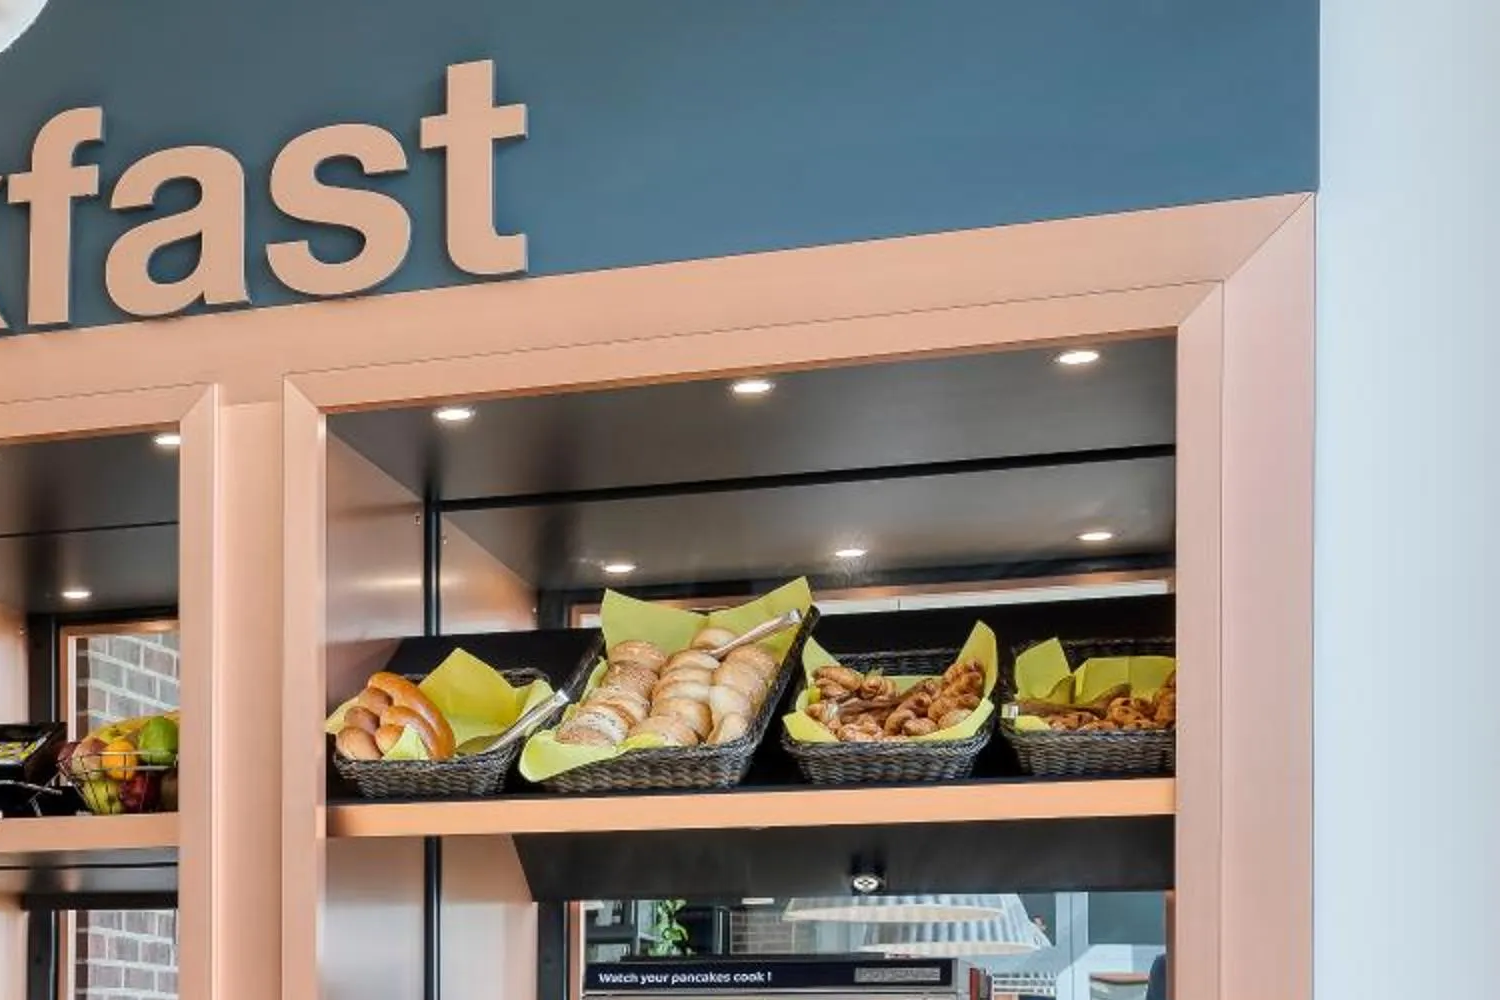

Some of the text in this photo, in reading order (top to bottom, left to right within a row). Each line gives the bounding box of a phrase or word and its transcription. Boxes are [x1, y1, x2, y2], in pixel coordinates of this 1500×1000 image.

[598, 972, 638, 983] Watch
[639, 973, 668, 985] your
[671, 971, 731, 985] pancakes
